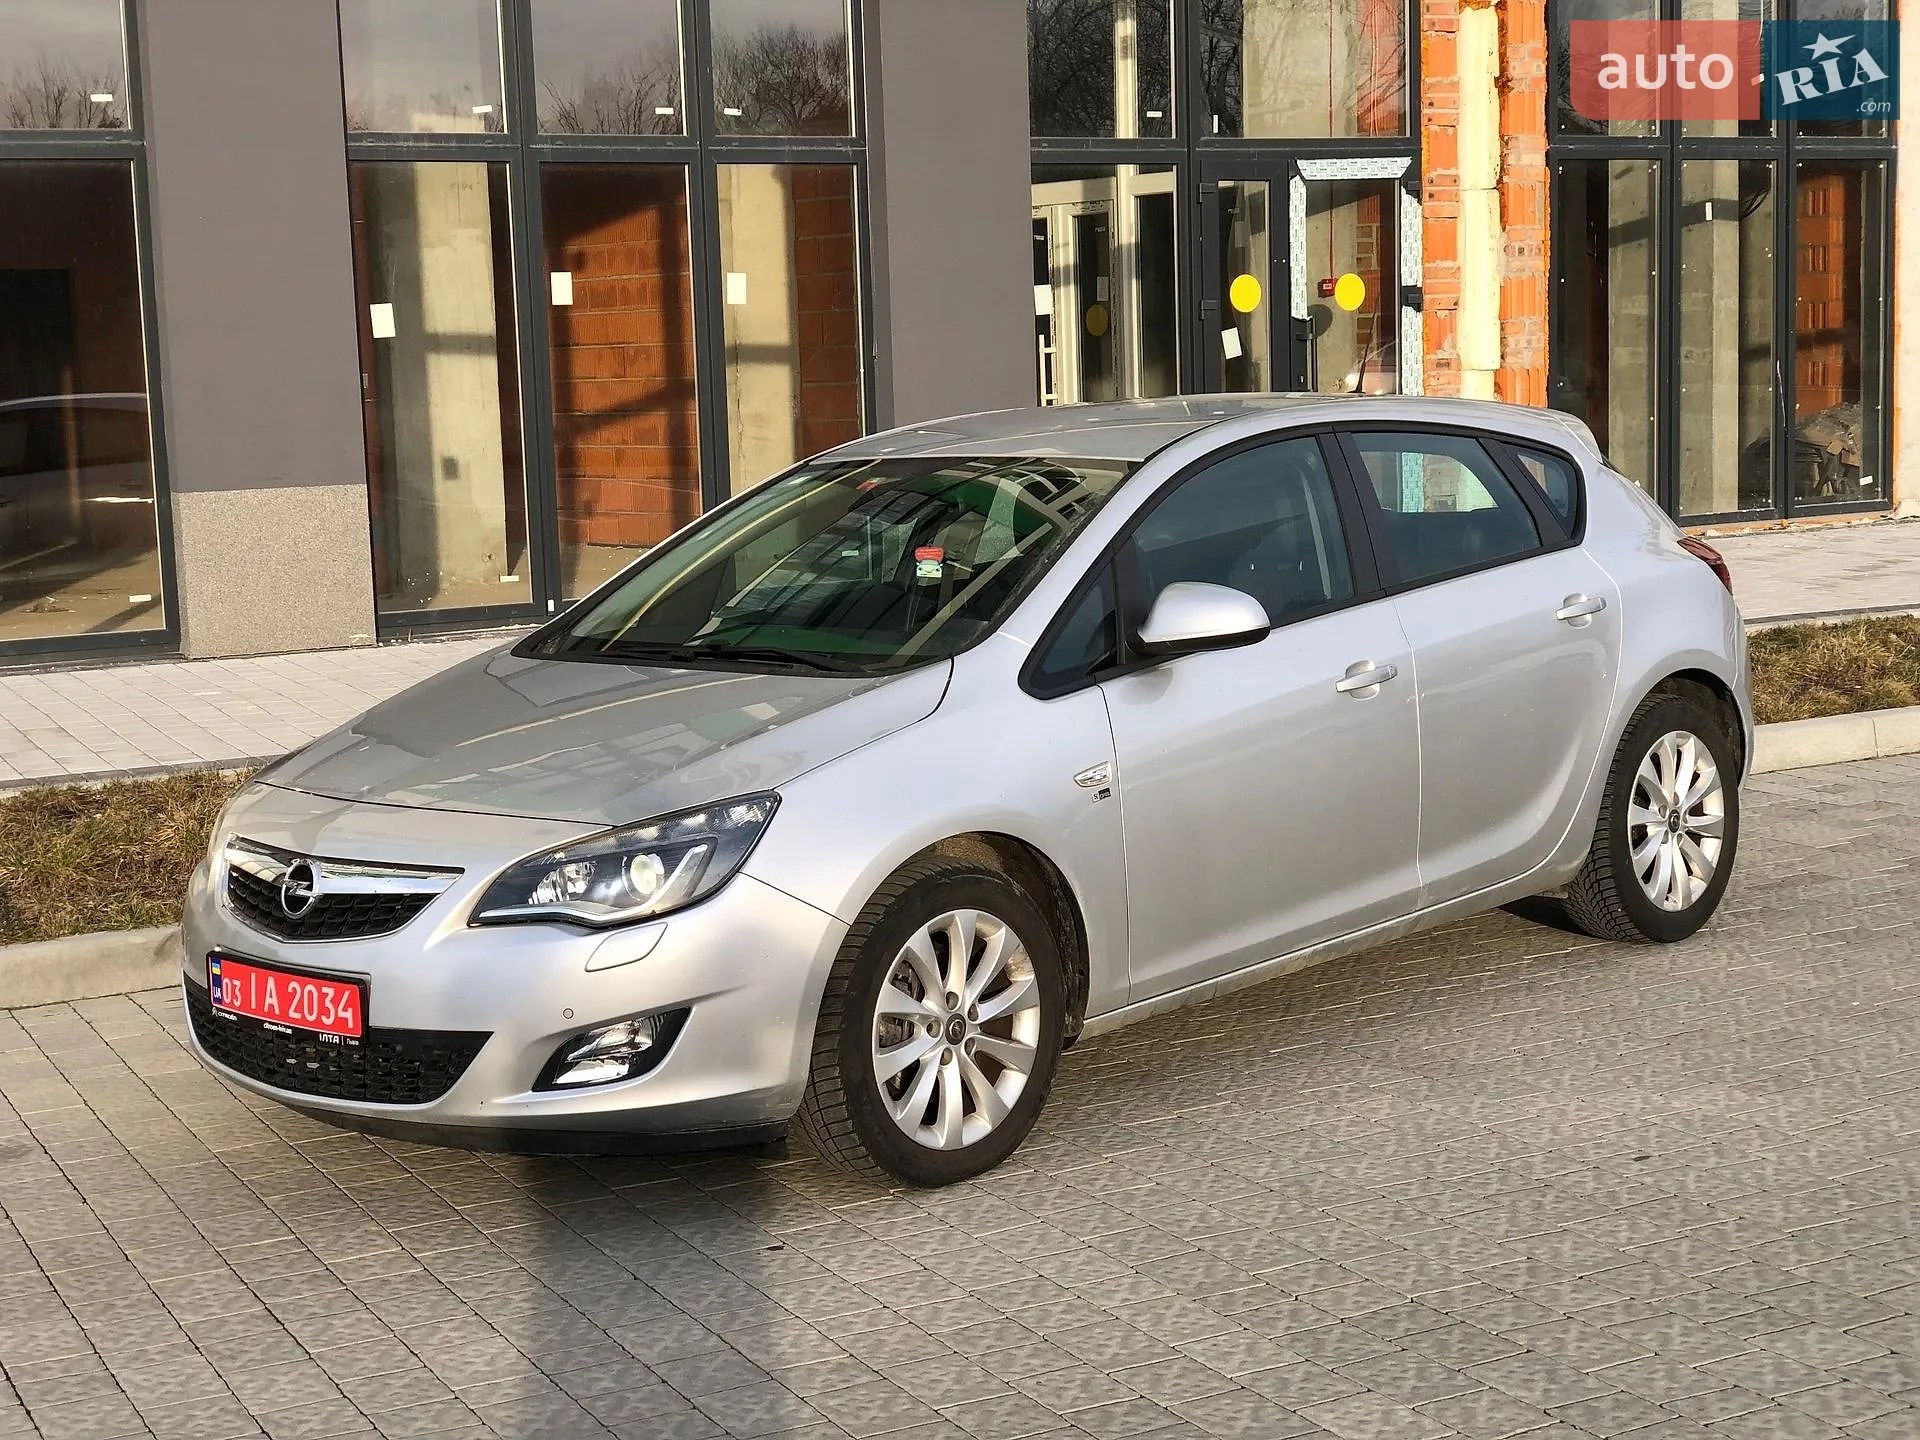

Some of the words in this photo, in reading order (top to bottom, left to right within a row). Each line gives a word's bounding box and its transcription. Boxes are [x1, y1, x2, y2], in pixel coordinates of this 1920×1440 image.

[213, 987, 222, 999] UA
[222, 977, 242, 1008] 03
[287, 980, 354, 1029] 2034
